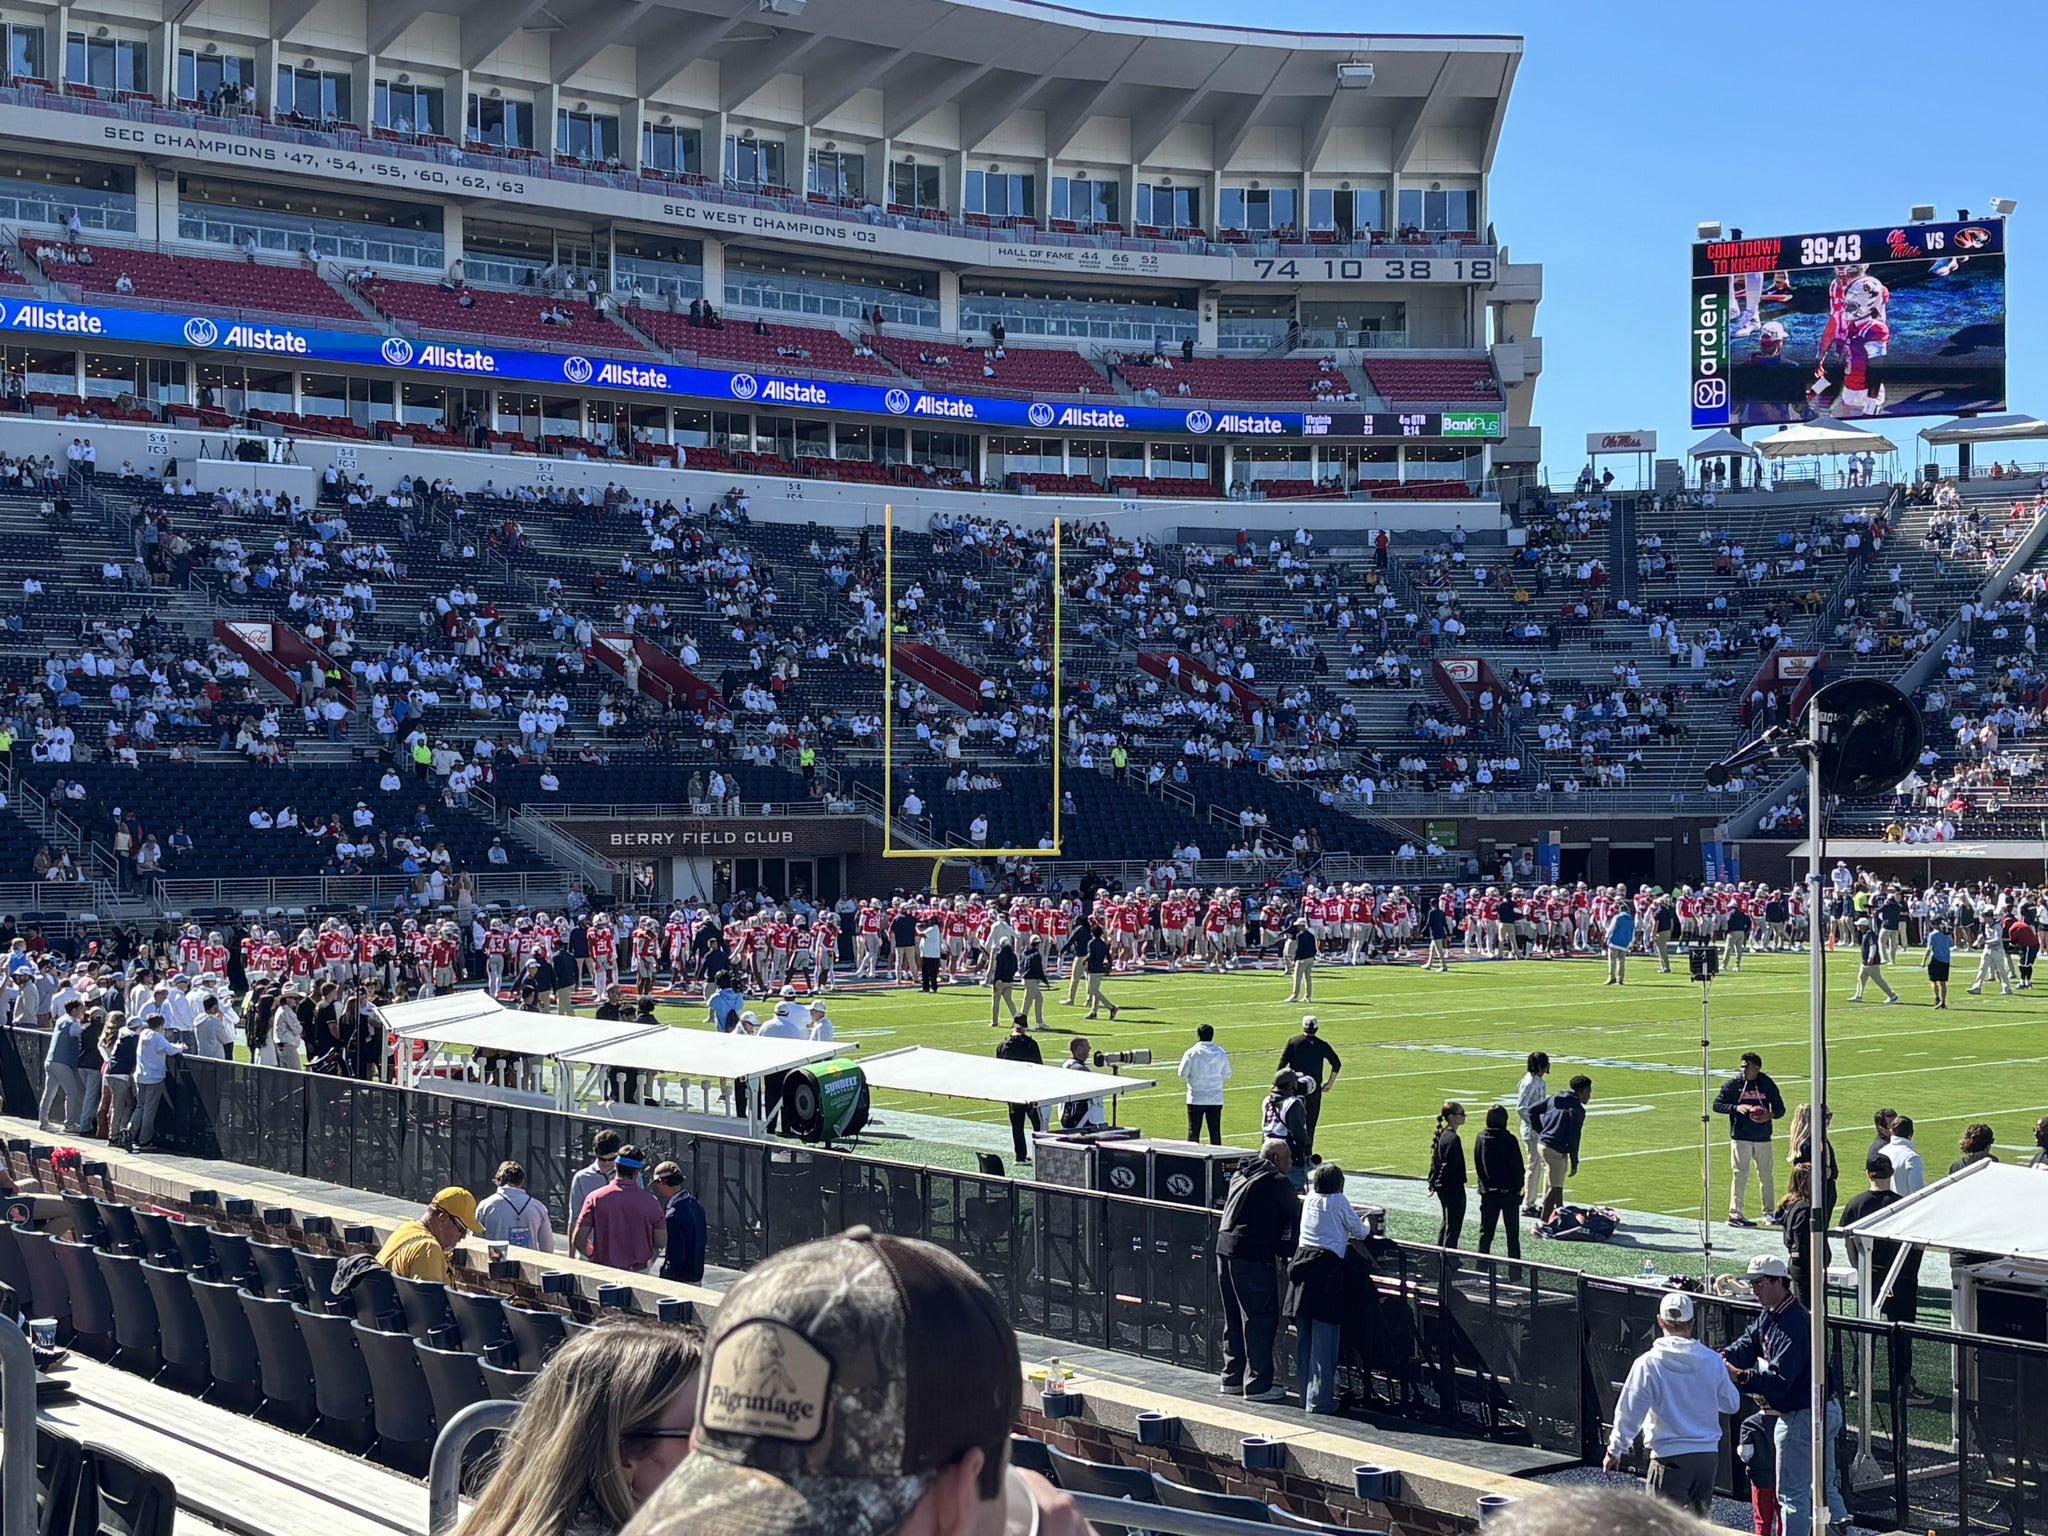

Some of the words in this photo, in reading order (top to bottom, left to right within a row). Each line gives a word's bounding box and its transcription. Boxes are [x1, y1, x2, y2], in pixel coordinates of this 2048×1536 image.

[104, 126, 144, 142] SEC
[154, 133, 276, 160] CHAMPIONS
[664, 204, 696, 219] SEC
[702, 209, 747, 225] WEST
[753, 216, 846, 239] CHAMPIONS
[1706, 238, 1780, 260] COUNTDOWN
[1801, 234, 1861, 265] 39:43
[1925, 232, 1944, 250] VS
[998, 248, 1026, 258] HALL
[1030, 250, 1044, 258] OF
[1046, 251, 1074, 260] FAME
[1081, 252, 1099, 260] 44
[1112, 253, 1130, 263] 66
[1141, 255, 1158, 265] 52
[1254, 260, 1300, 280] 74
[1324, 260, 1362, 280] 10
[1385, 260, 1432, 280] 38
[1454, 260, 1492, 280] 18
[1713, 260, 1728, 276] TO
[1730, 255, 1778, 273] KICKOFF
[1693, 293, 1718, 376] arden
[1442, 416, 1498, 431] BankPlus
[610, 833, 674, 846] BERRY
[682, 832, 736, 844] FIELD
[744, 832, 793, 844] CLUB
[824, 1076, 858, 1094] SUNBELT
